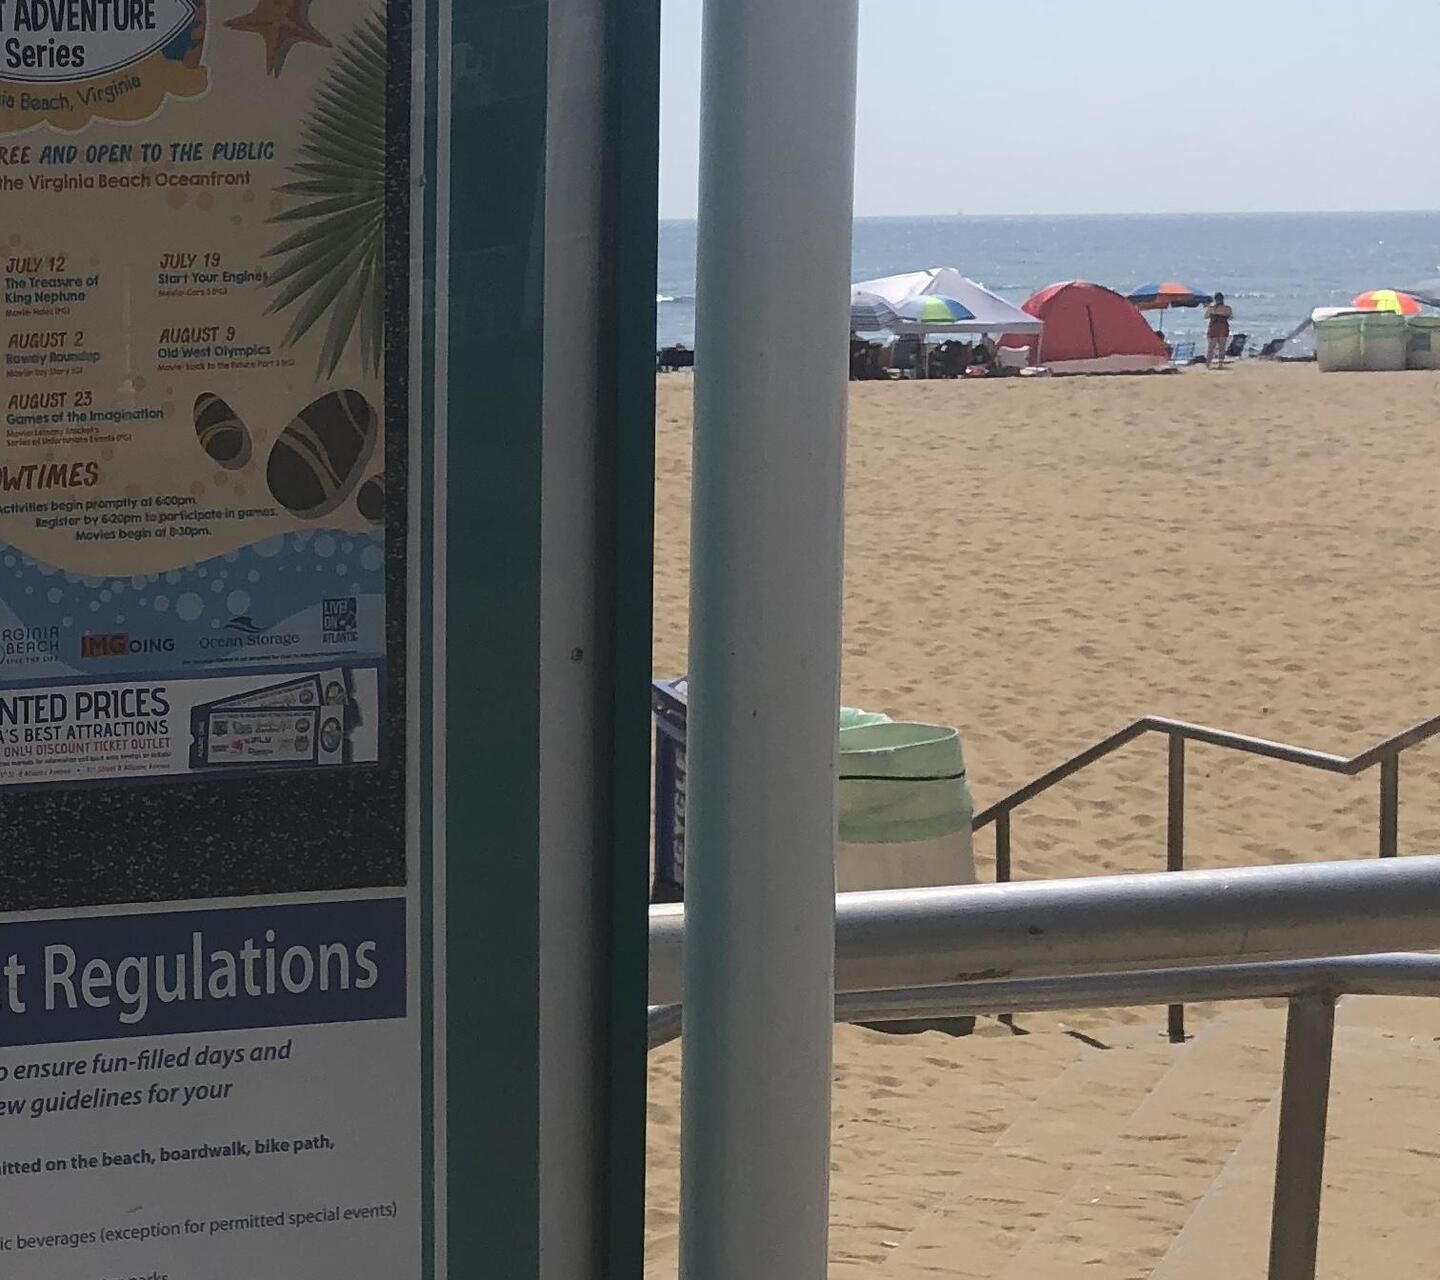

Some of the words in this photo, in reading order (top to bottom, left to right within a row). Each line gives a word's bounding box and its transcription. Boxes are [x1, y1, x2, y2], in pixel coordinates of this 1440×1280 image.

[5, 38, 85, 69] Series
[78, 76, 141, 106] Virginia
[39, 144, 78, 166] AND
[85, 143, 133, 164] OPEN
[140, 142, 163, 163] TO
[169, 141, 204, 163] THE
[212, 140, 275, 162] PUBLIC
[28, 172, 94, 194] Virginia
[98, 172, 151, 190] Beach
[154, 169, 251, 187] Oceanfront
[5, 256, 42, 273] JULY
[48, 256, 65, 272] 12
[160, 253, 197, 269] JULY
[204, 252, 221, 268] 19
[8, 332, 68, 349] AUGUST
[74, 331, 84, 347] 2
[160, 327, 220, 344] AUGUST
[226, 327, 236, 341] 9
[158, 347, 181, 359] Old
[184, 345, 211, 359] West
[214, 344, 271, 360] Olympics
[8, 392, 67, 409] AUGUST
[74, 391, 93, 407] 23
[6, 639, 59, 655] BEACH
[199, 637, 244, 649] Ocean
[247, 632, 301, 648] Storage
[75, 687, 171, 720] PRICES
[24, 724, 62, 743] BEST
[66, 719, 169, 741] ATTRACTIONS
[3, 744, 33, 759] ONLY
[35, 741, 91, 756] DISCOUNT
[93, 738, 129, 753] TICKET
[130, 736, 170, 751] OUTLET
[44, 929, 379, 1024] Regulations
[13, 1059, 88, 1081] ensure
[92, 1045, 191, 1075] fun-filled
[194, 1044, 245, 1071] days
[249, 1038, 292, 1063] and
[30, 1086, 143, 1120] guidelines
[147, 1082, 180, 1105] for
[181, 1083, 233, 1107] your
[45, 1158, 67, 1172] on
[70, 1153, 99, 1170] the
[102, 1148, 156, 1168] beach,
[159, 1140, 251, 1163] boardwalk,
[255, 1137, 290, 1155] bike
[293, 1134, 335, 1156] path,
